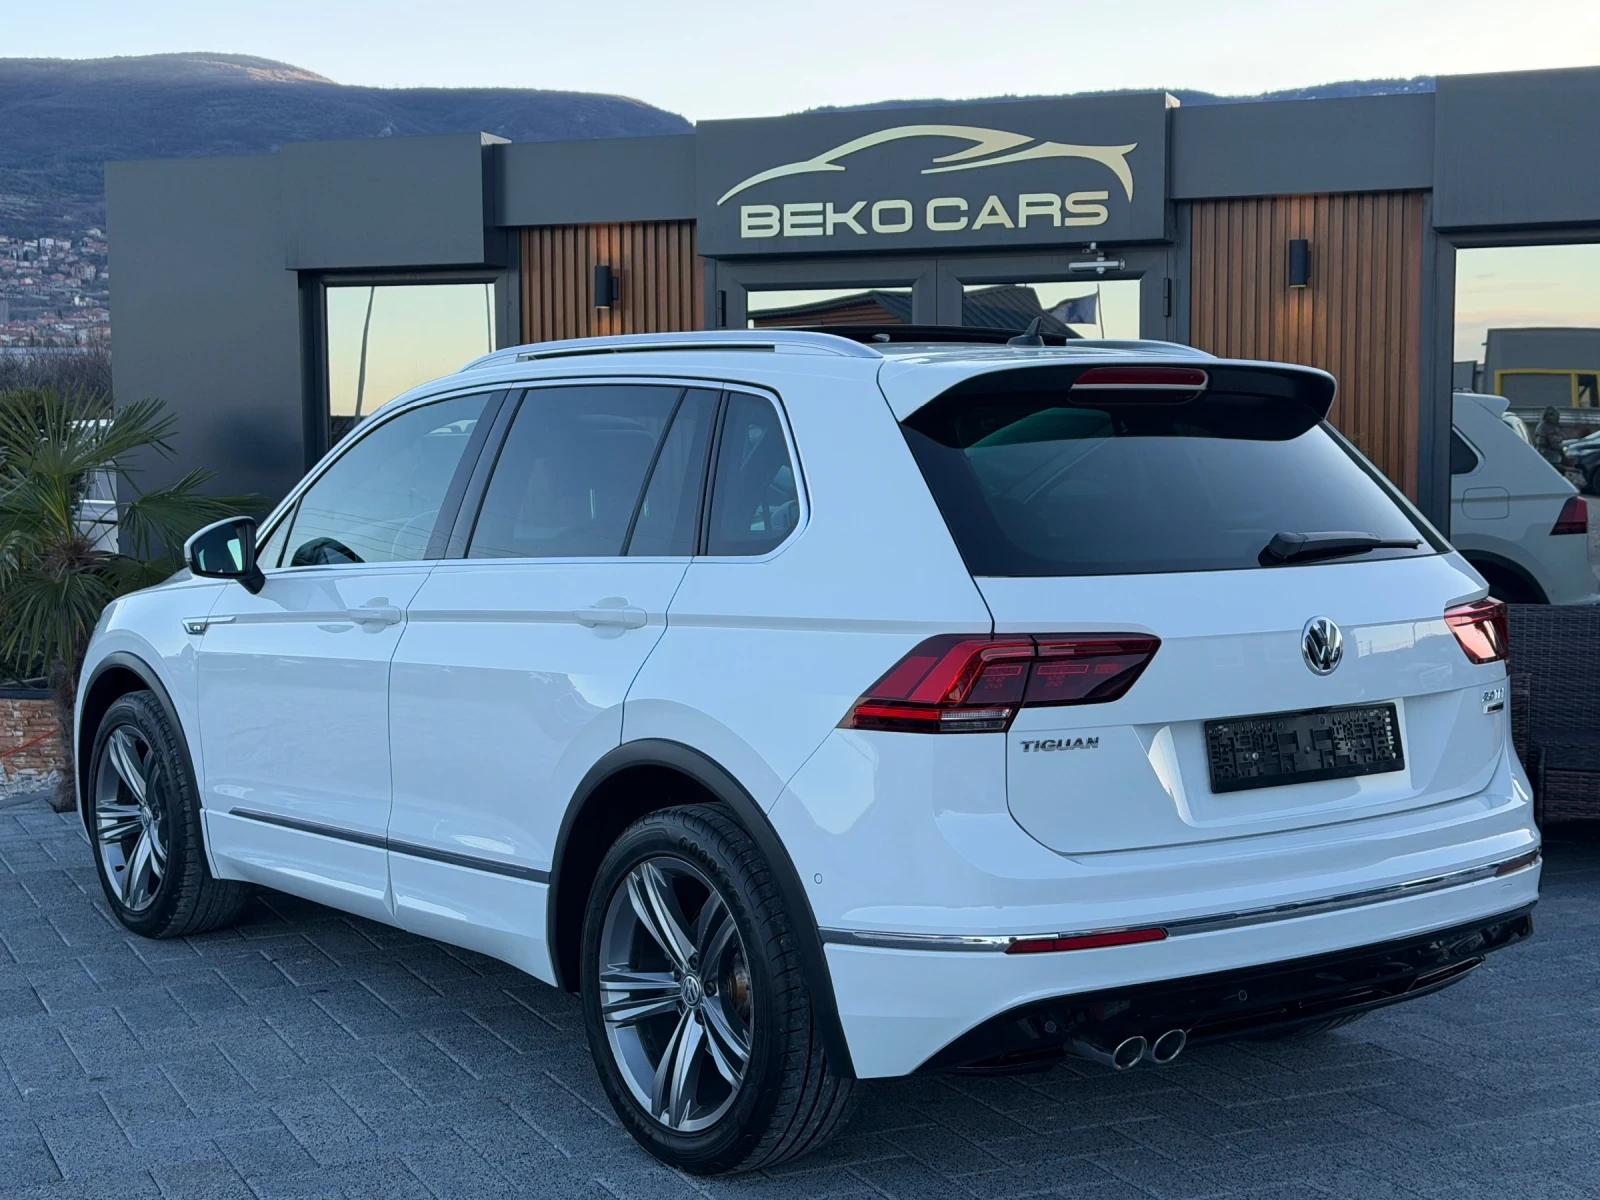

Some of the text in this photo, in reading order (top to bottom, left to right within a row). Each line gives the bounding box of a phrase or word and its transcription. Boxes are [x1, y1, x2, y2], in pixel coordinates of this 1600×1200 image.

[740, 190, 1109, 238] BEKO CARS
[1020, 736, 1099, 752] TIGUAN
